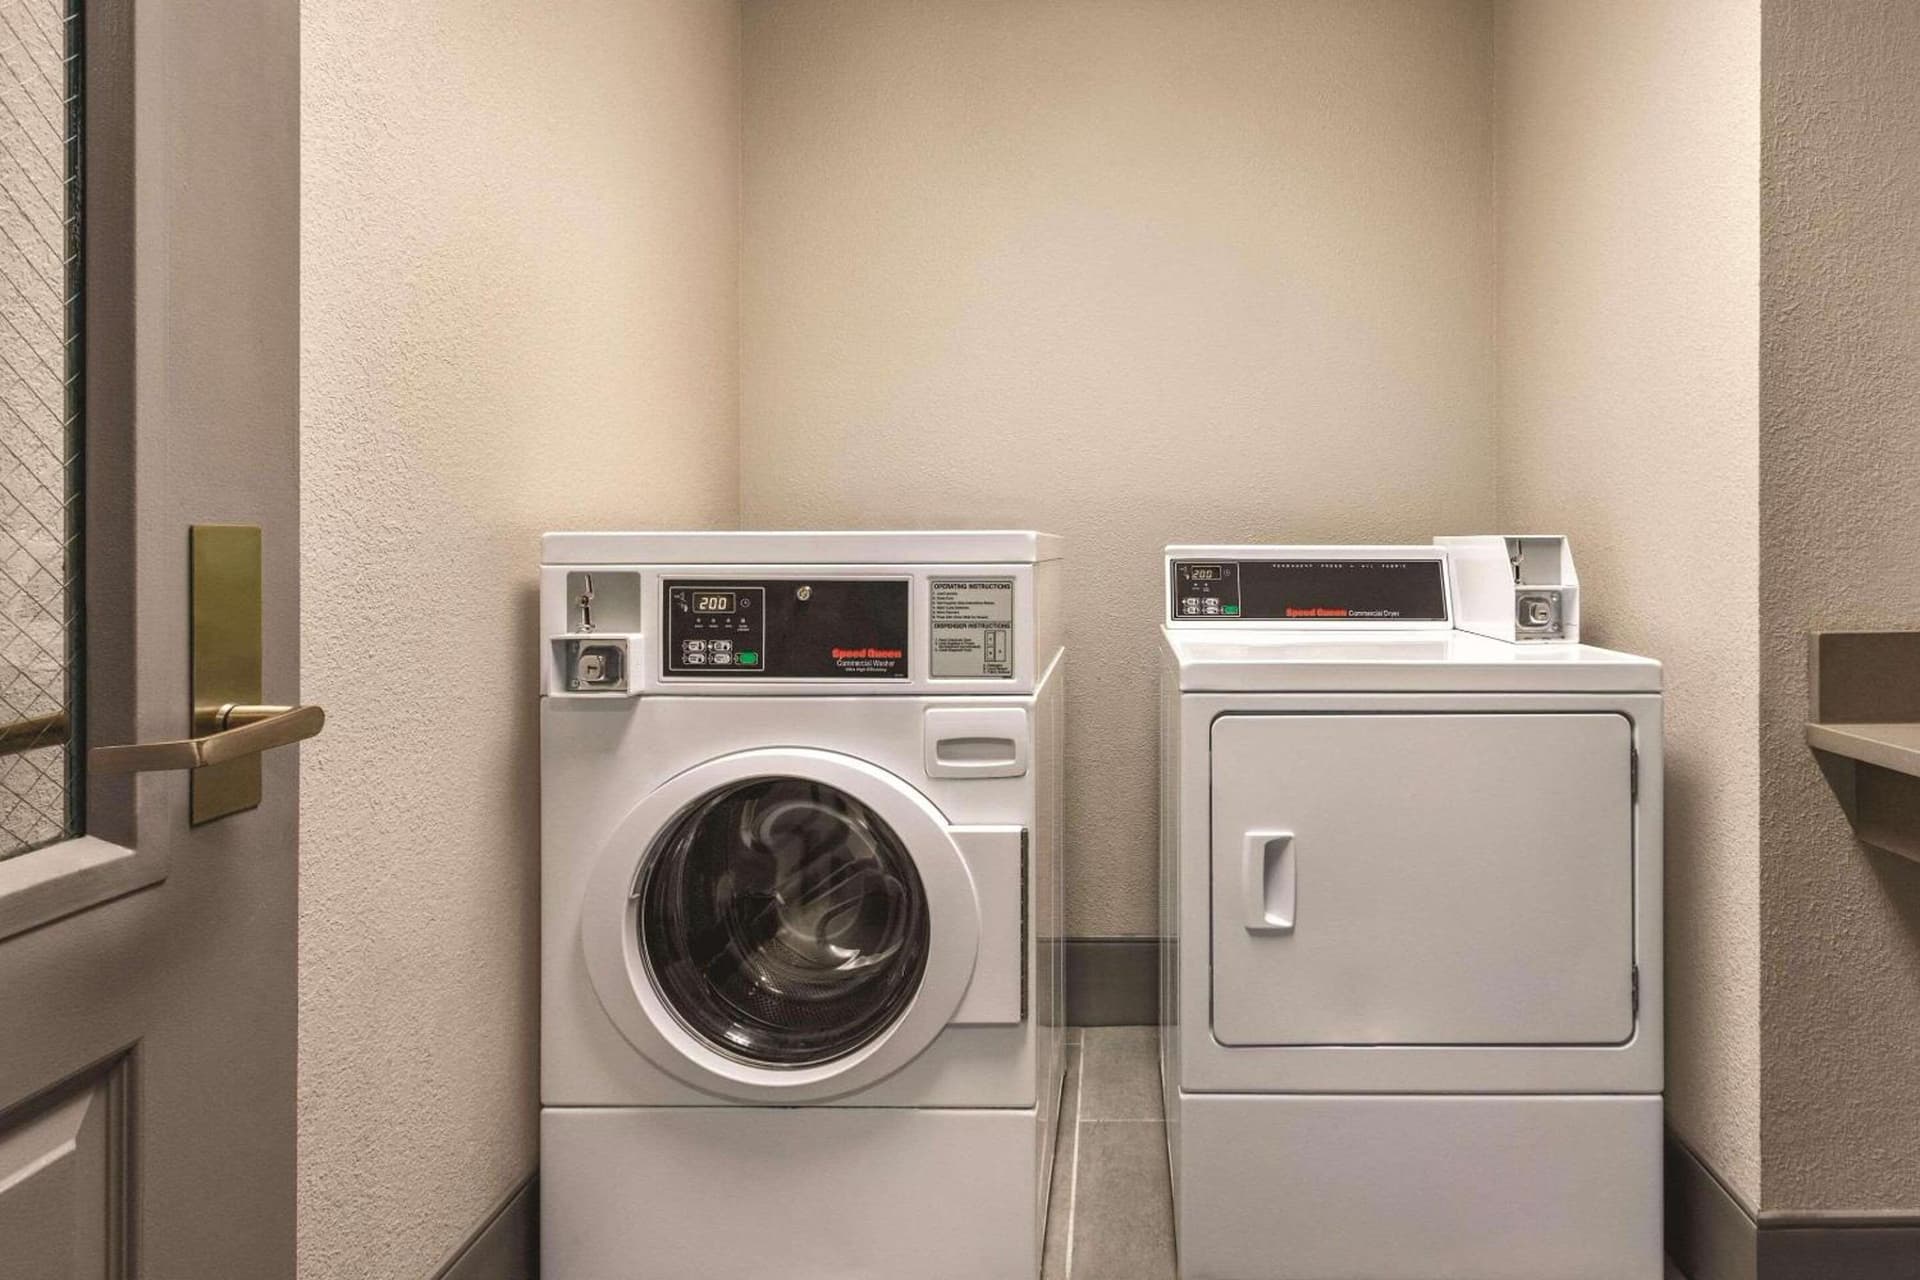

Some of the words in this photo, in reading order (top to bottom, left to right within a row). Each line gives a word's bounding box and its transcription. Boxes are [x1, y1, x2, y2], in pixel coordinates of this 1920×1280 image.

[1192, 569, 1213, 578] 200
[699, 597, 727, 610] 200
[1286, 607, 1316, 617] Speed
[1317, 607, 1347, 617] Queen
[1348, 609, 1382, 617] Commercial
[1383, 609, 1400, 618] Dryer
[832, 648, 866, 660] Speed
[867, 648, 902, 659] Queen
